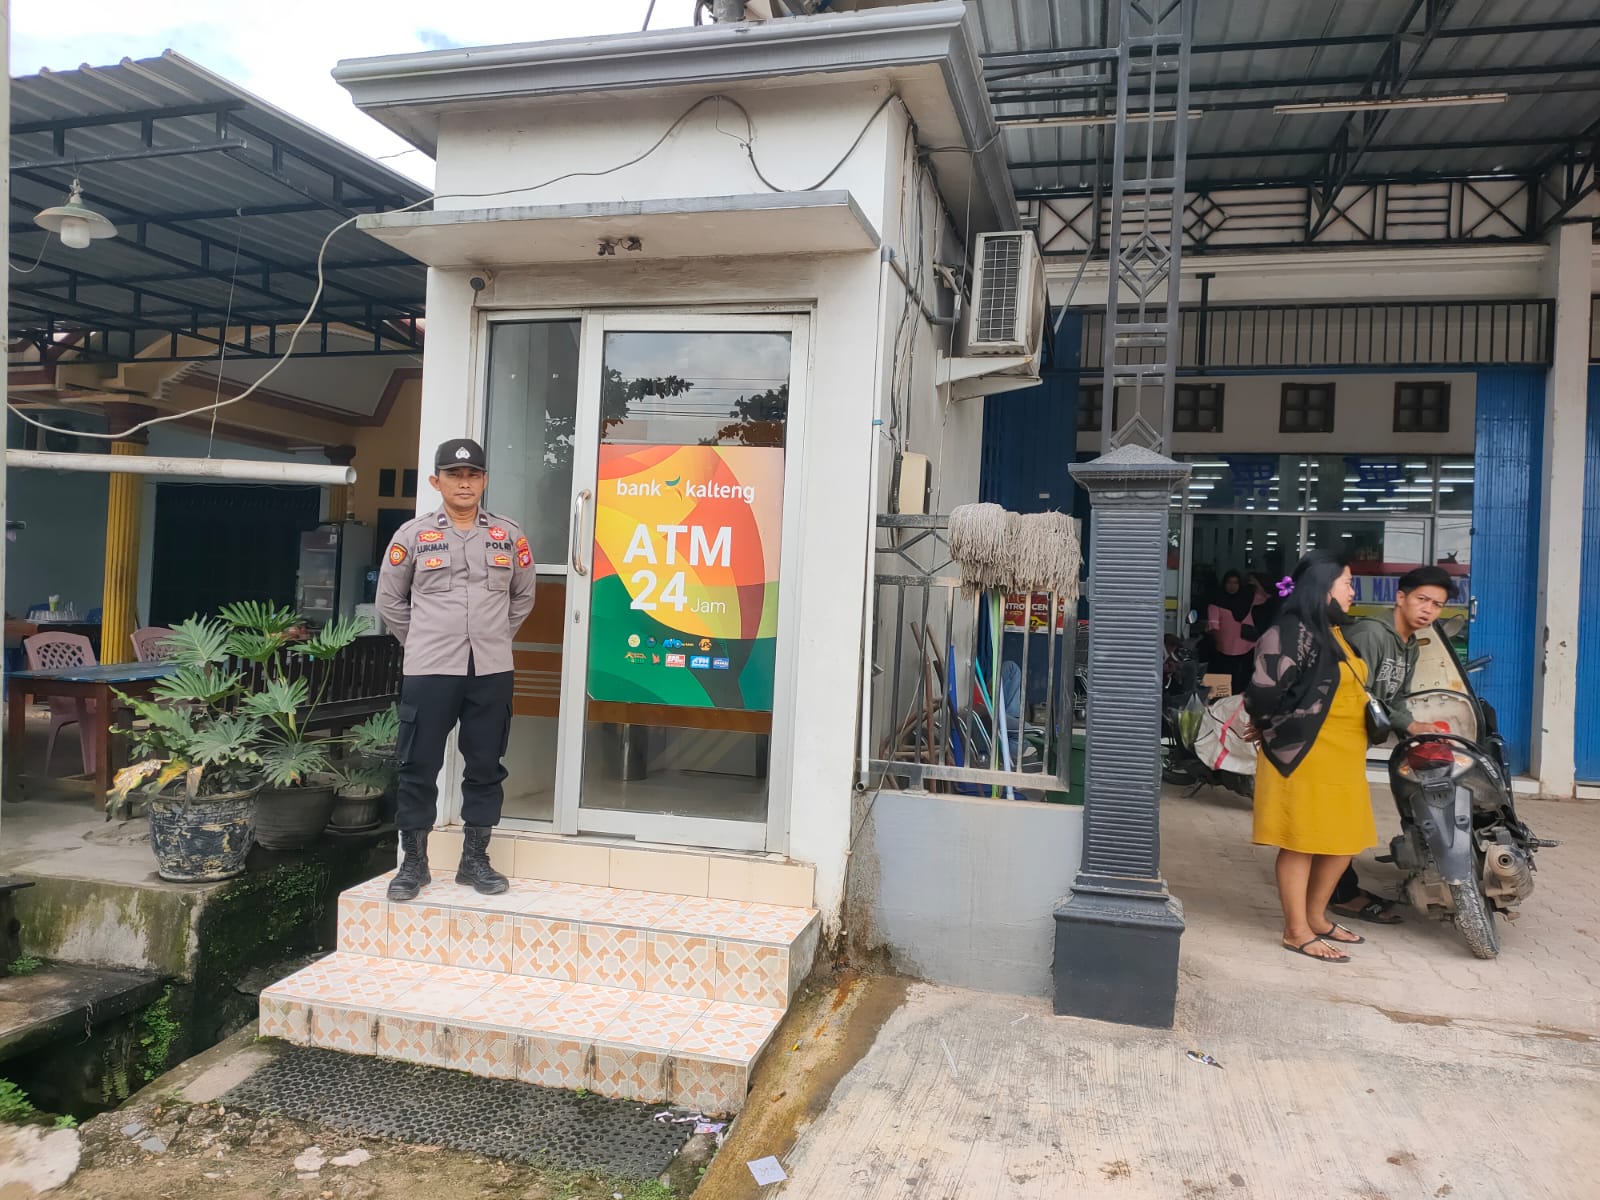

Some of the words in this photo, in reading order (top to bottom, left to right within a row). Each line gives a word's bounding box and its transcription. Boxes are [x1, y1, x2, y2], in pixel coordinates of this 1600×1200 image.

[616, 478, 662, 496] bank
[685, 480, 755, 504] kalteng
[417, 543, 449, 554] LUKMAN
[622, 523, 732, 567] ATM
[630, 569, 688, 612] 24
[690, 599, 726, 614] Jam
